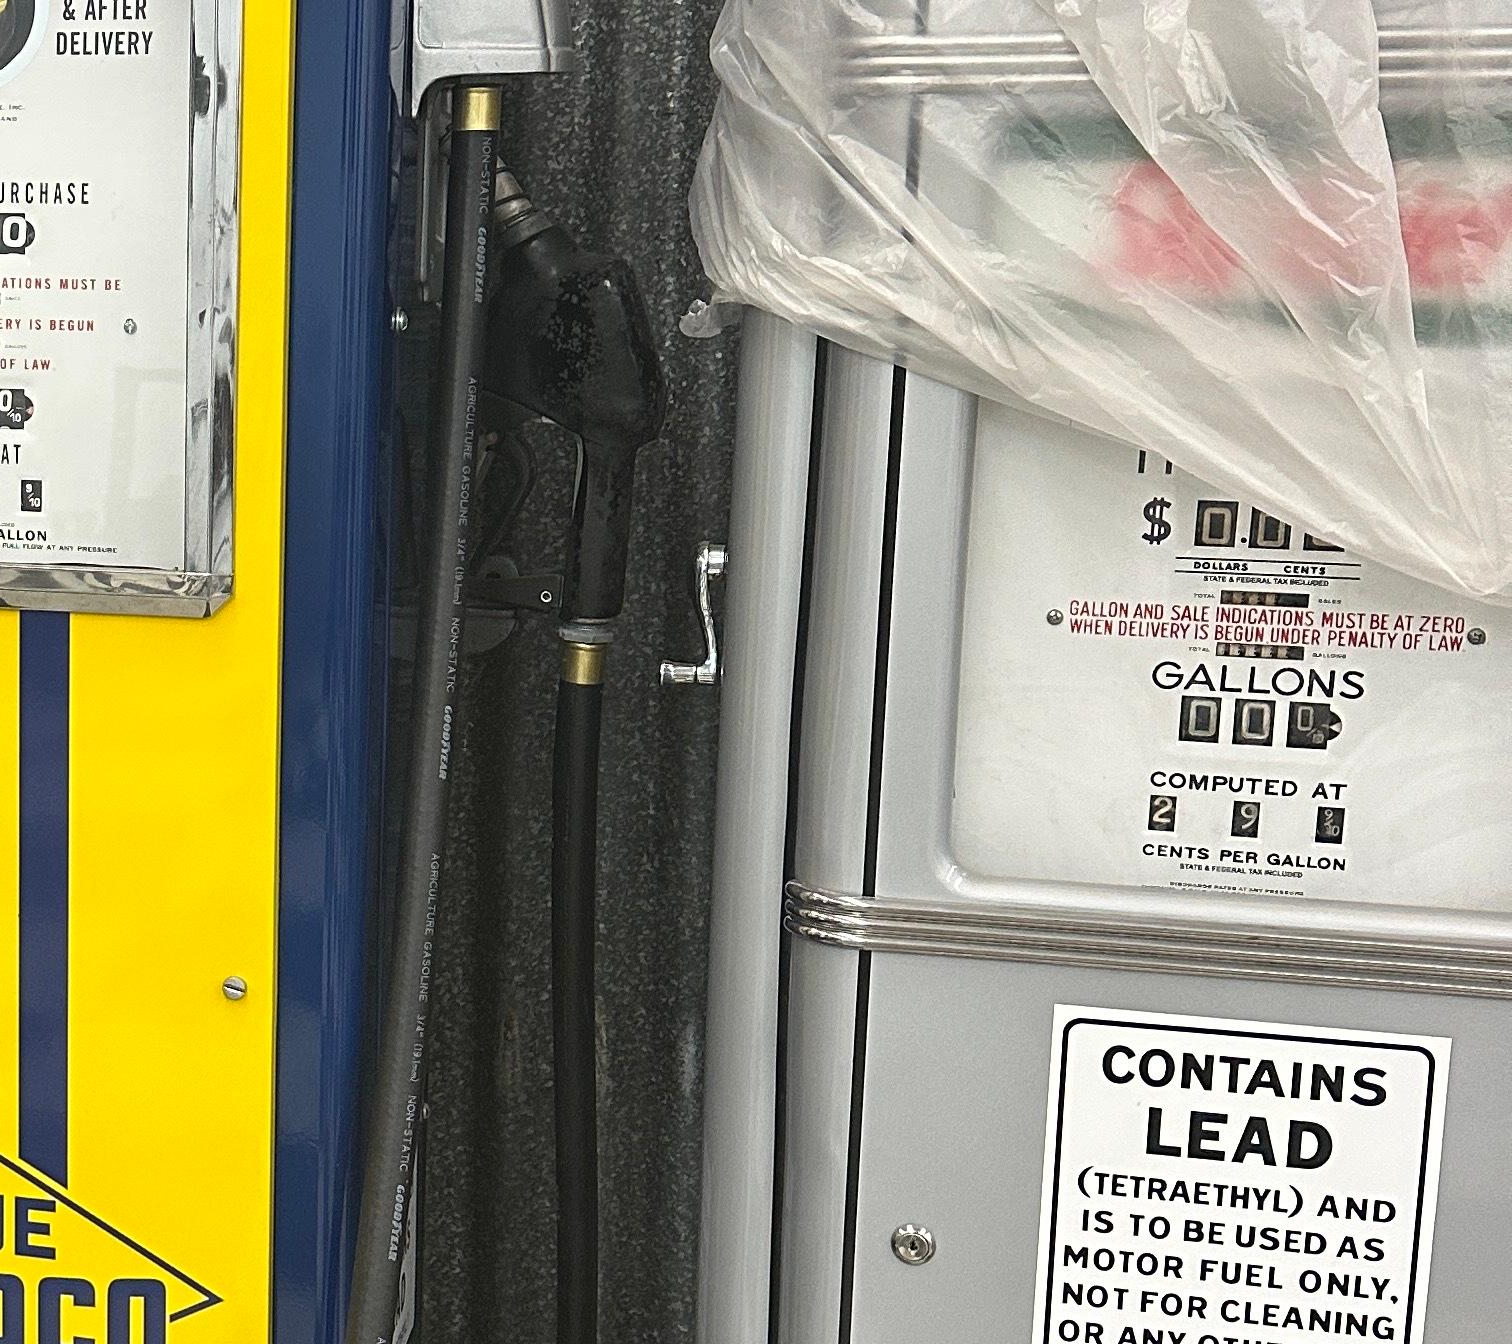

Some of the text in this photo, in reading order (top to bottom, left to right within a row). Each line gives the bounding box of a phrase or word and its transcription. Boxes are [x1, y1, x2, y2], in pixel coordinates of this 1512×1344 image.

[56, 31, 153, 56] DELIVERY
[480, 137, 492, 215] NON-STATIC
[59, 278, 97, 290] MUST
[105, 279, 121, 291] BE
[474, 226, 486, 303] GOODYEAR
[29, 319, 42, 331] IS
[49, 319, 95, 332] BEGUN
[0, 358, 16, 370] OF
[463, 377, 478, 460] AGRICULTURE
[1, 444, 21, 464] AT
[458, 465, 472, 526] GASOLINE
[1194, 561, 1326, 575] DOLLARS CENTS
[1203, 575, 1227, 583] STATE
[1290, 579, 1329, 587] INCLUDED
[1070, 600, 1464, 634] GALLON AND SALE INDICATIONS MUST BE AT ZERO
[1070, 618, 1112, 635] WHEN
[1118, 620, 1190, 639] DELIVERY
[1194, 623, 1209, 640] IS
[1271, 628, 1320, 645] UNDER
[1328, 631, 1398, 649] PENALTY
[1403, 633, 1423, 650] OF
[446, 617, 460, 693] NON-STATIC
[1152, 661, 1365, 699] GALLONS
[439, 706, 453, 780] GOODYEAR
[1150, 771, 1347, 800] COMPUTED AT
[1153, 797, 1257, 829] 2 9
[1142, 844, 1346, 871] CENTS PER GALLON
[1212, 866, 1246, 874] FEDERAL
[1264, 870, 1303, 878] INCLUDED
[425, 853, 440, 936] AGRICULTURE
[419, 941, 432, 1002] GASOLINE
[1102, 1045, 1387, 1107] CONTAINS
[400, 1095, 417, 1172] NON-STATIC
[1145, 1107, 1333, 1169] LEAD
[1077, 1166, 1396, 1224] (TETRAETHYL) AND
[388, 1184, 405, 1262] GOODYEAR
[1082, 1210, 1385, 1262] IS TO BE USED AS
[1064, 1244, 1183, 1280] MOTOR
[1200, 1260, 1283, 1290] FUEL
[1058, 1319, 1104, 1344] OR
[1062, 1283, 1395, 1341] NOT FOR CLEANING
